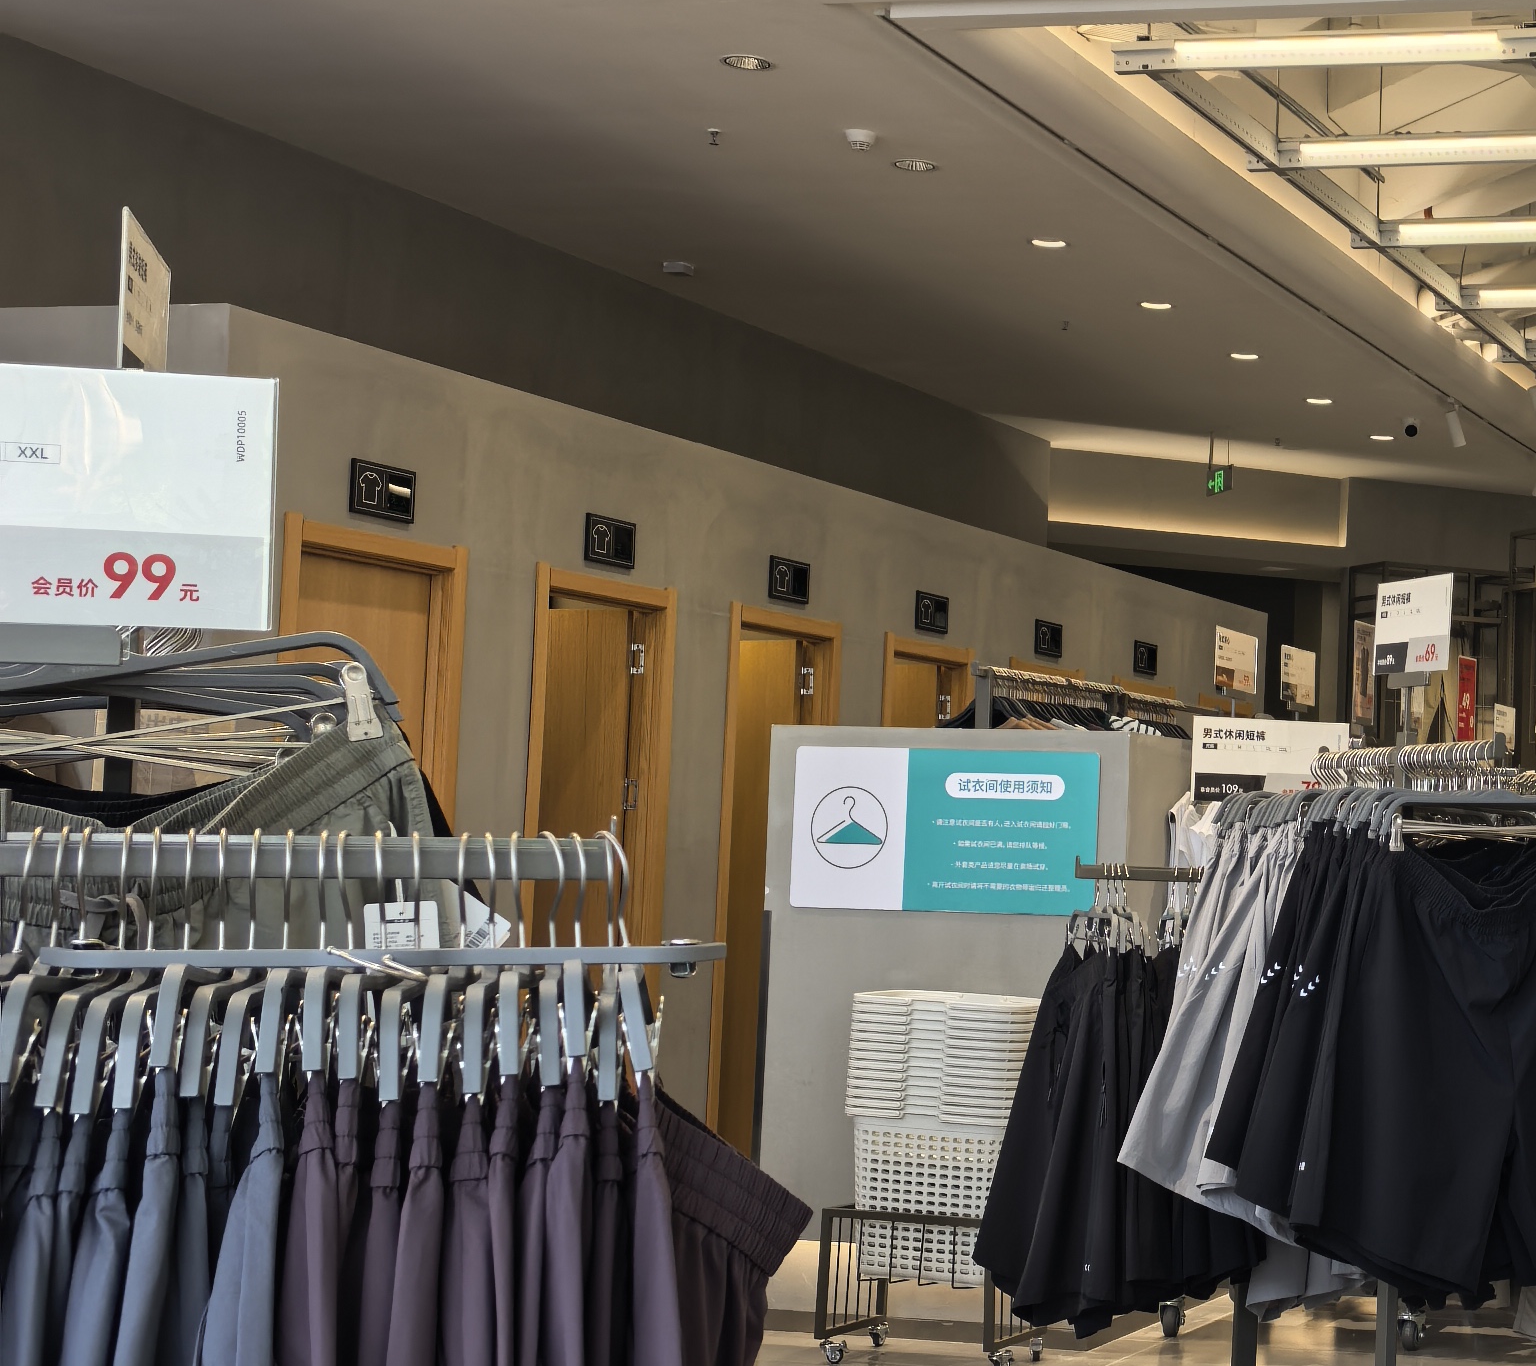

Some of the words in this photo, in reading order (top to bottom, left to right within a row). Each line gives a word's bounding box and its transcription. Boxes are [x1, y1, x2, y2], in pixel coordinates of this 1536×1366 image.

[236, 410, 247, 463] WDP10005
[17, 445, 49, 460] XXL
[1202, 727, 1267, 742] 男式休闲短裤
[958, 778, 1053, 794] 试衣间使用须知
